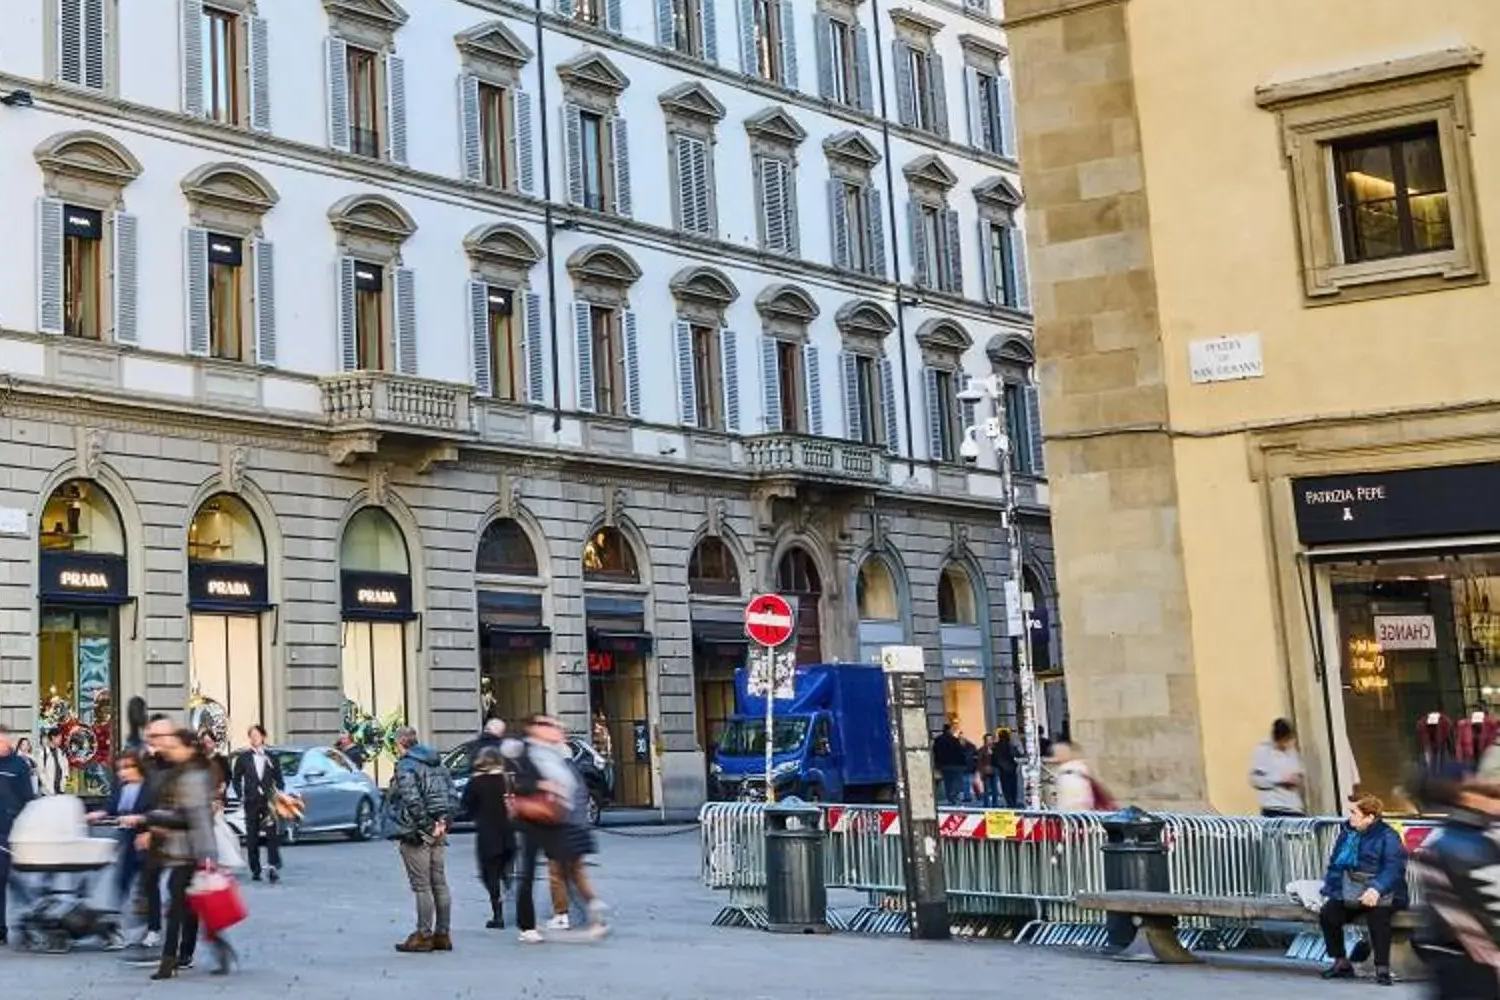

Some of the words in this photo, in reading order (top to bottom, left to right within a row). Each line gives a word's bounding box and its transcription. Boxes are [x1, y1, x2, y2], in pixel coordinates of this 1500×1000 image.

[1305, 488, 1354, 504] PATRIZIA
[1356, 486, 1386, 500] PEPE
[60, 571, 108, 588] PRADA
[207, 580, 251, 596] PRADA
[357, 588, 397, 603] PRADA
